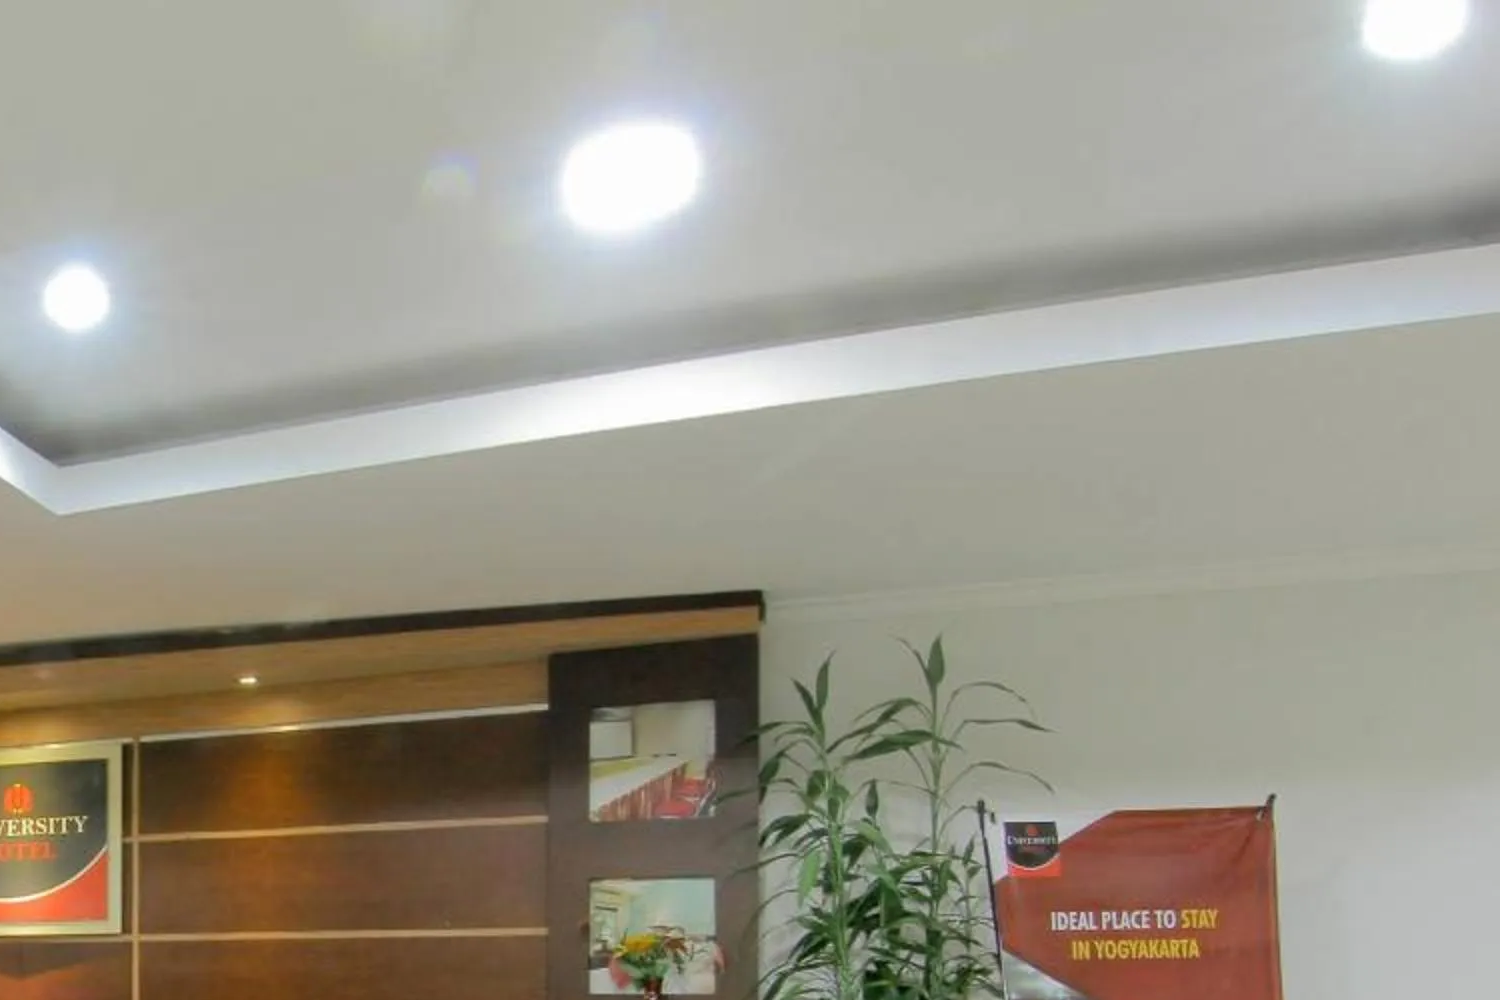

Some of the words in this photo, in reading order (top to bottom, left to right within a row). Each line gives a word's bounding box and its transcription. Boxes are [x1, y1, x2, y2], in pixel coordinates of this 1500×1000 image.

[1051, 911, 1098, 931] IDEAL
[1101, 911, 1151, 930] PLACE
[1155, 910, 1177, 929] TO
[1180, 909, 1219, 929] STAY
[1072, 940, 1091, 960] IN
[1095, 939, 1200, 959] YOGYAKARTA
